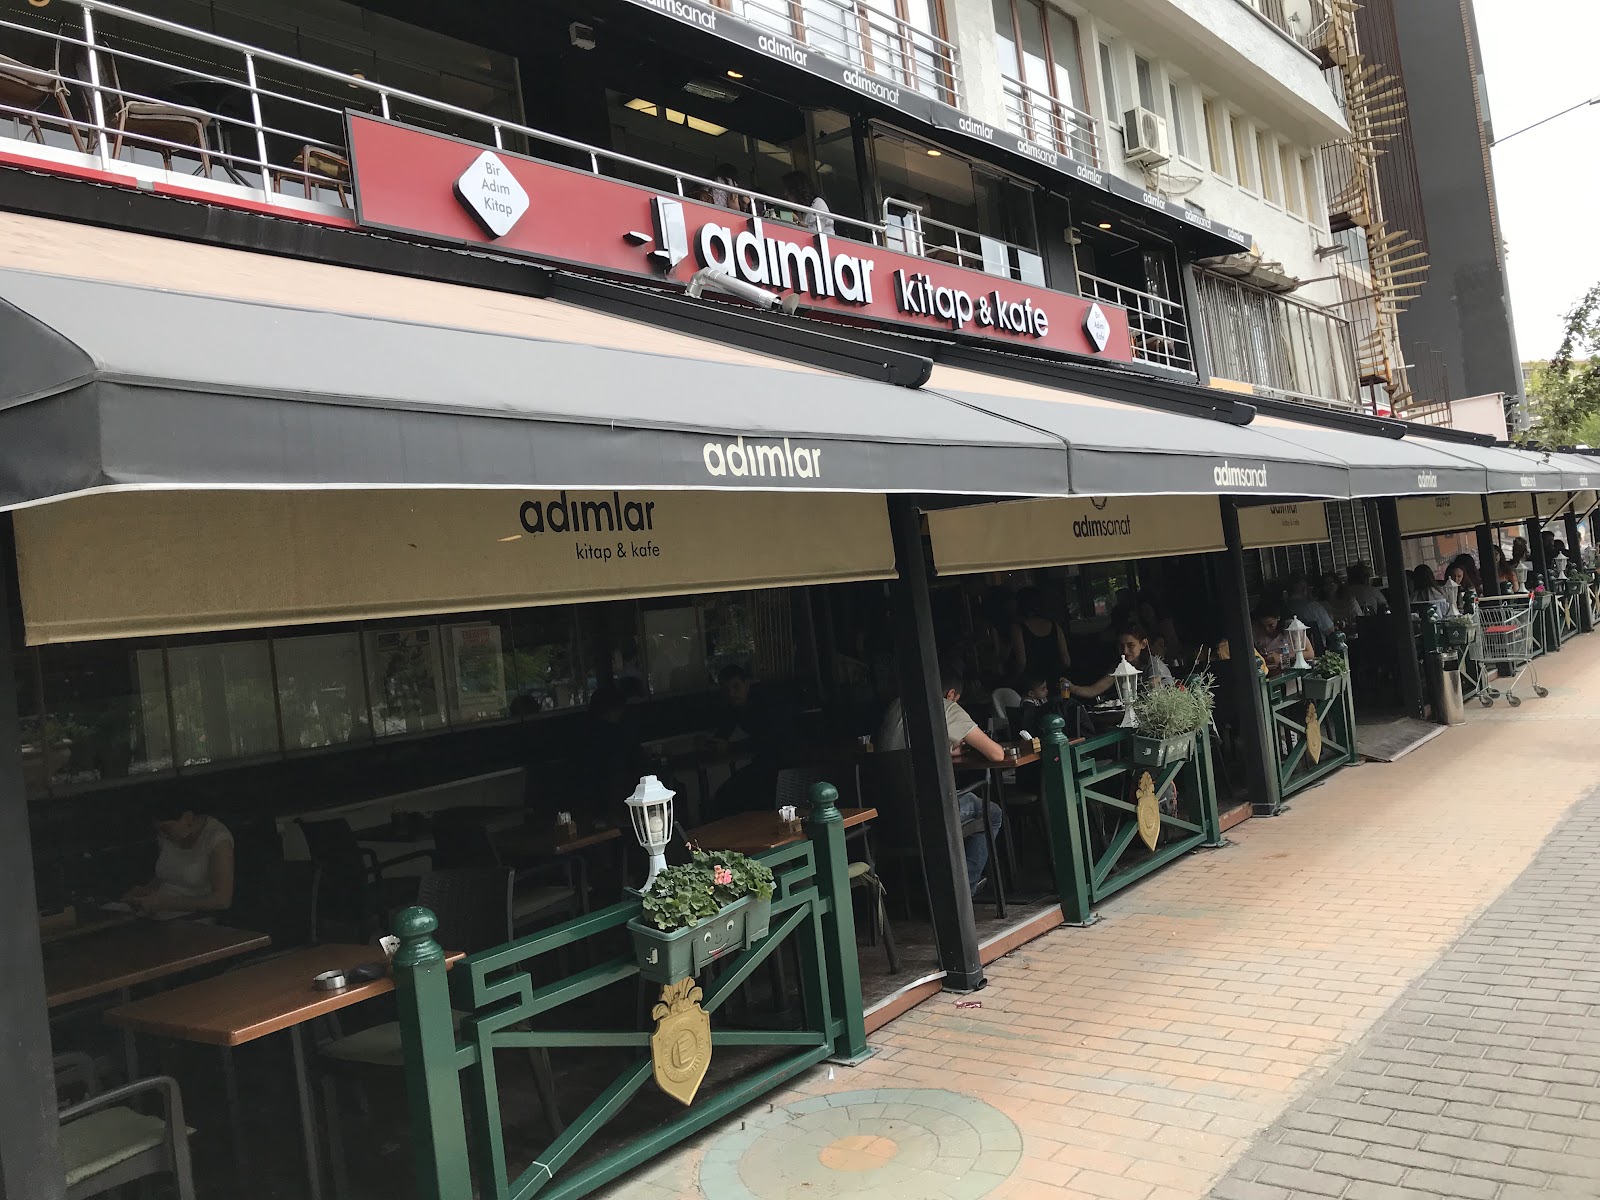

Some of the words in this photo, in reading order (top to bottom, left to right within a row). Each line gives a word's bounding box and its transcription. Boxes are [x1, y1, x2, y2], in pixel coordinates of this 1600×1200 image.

[640, 0, 716, 30] ımsanat
[758, 35, 807, 66] adımlar
[843, 69, 899, 104] adımsanat
[958, 117, 993, 140] adımlar
[1017, 139, 1058, 166] adımsanat
[485, 162, 500, 176] Bir
[1076, 164, 1103, 185] adımlar
[481, 178, 510, 195] Adım
[484, 197, 513, 217] Kitap
[699, 216, 875, 304] adımlar
[897, 268, 973, 329] kitap
[978, 295, 994, 325] &
[994, 290, 1049, 337] kafe
[703, 434, 821, 478] adımlar
[1213, 460, 1268, 487] adımsanat
[519, 490, 655, 534] adımlar
[1073, 514, 1131, 538] adımsanat
[576, 542, 612, 563] kitap
[617, 544, 627, 558] &
[631, 541, 660, 558] kafe
